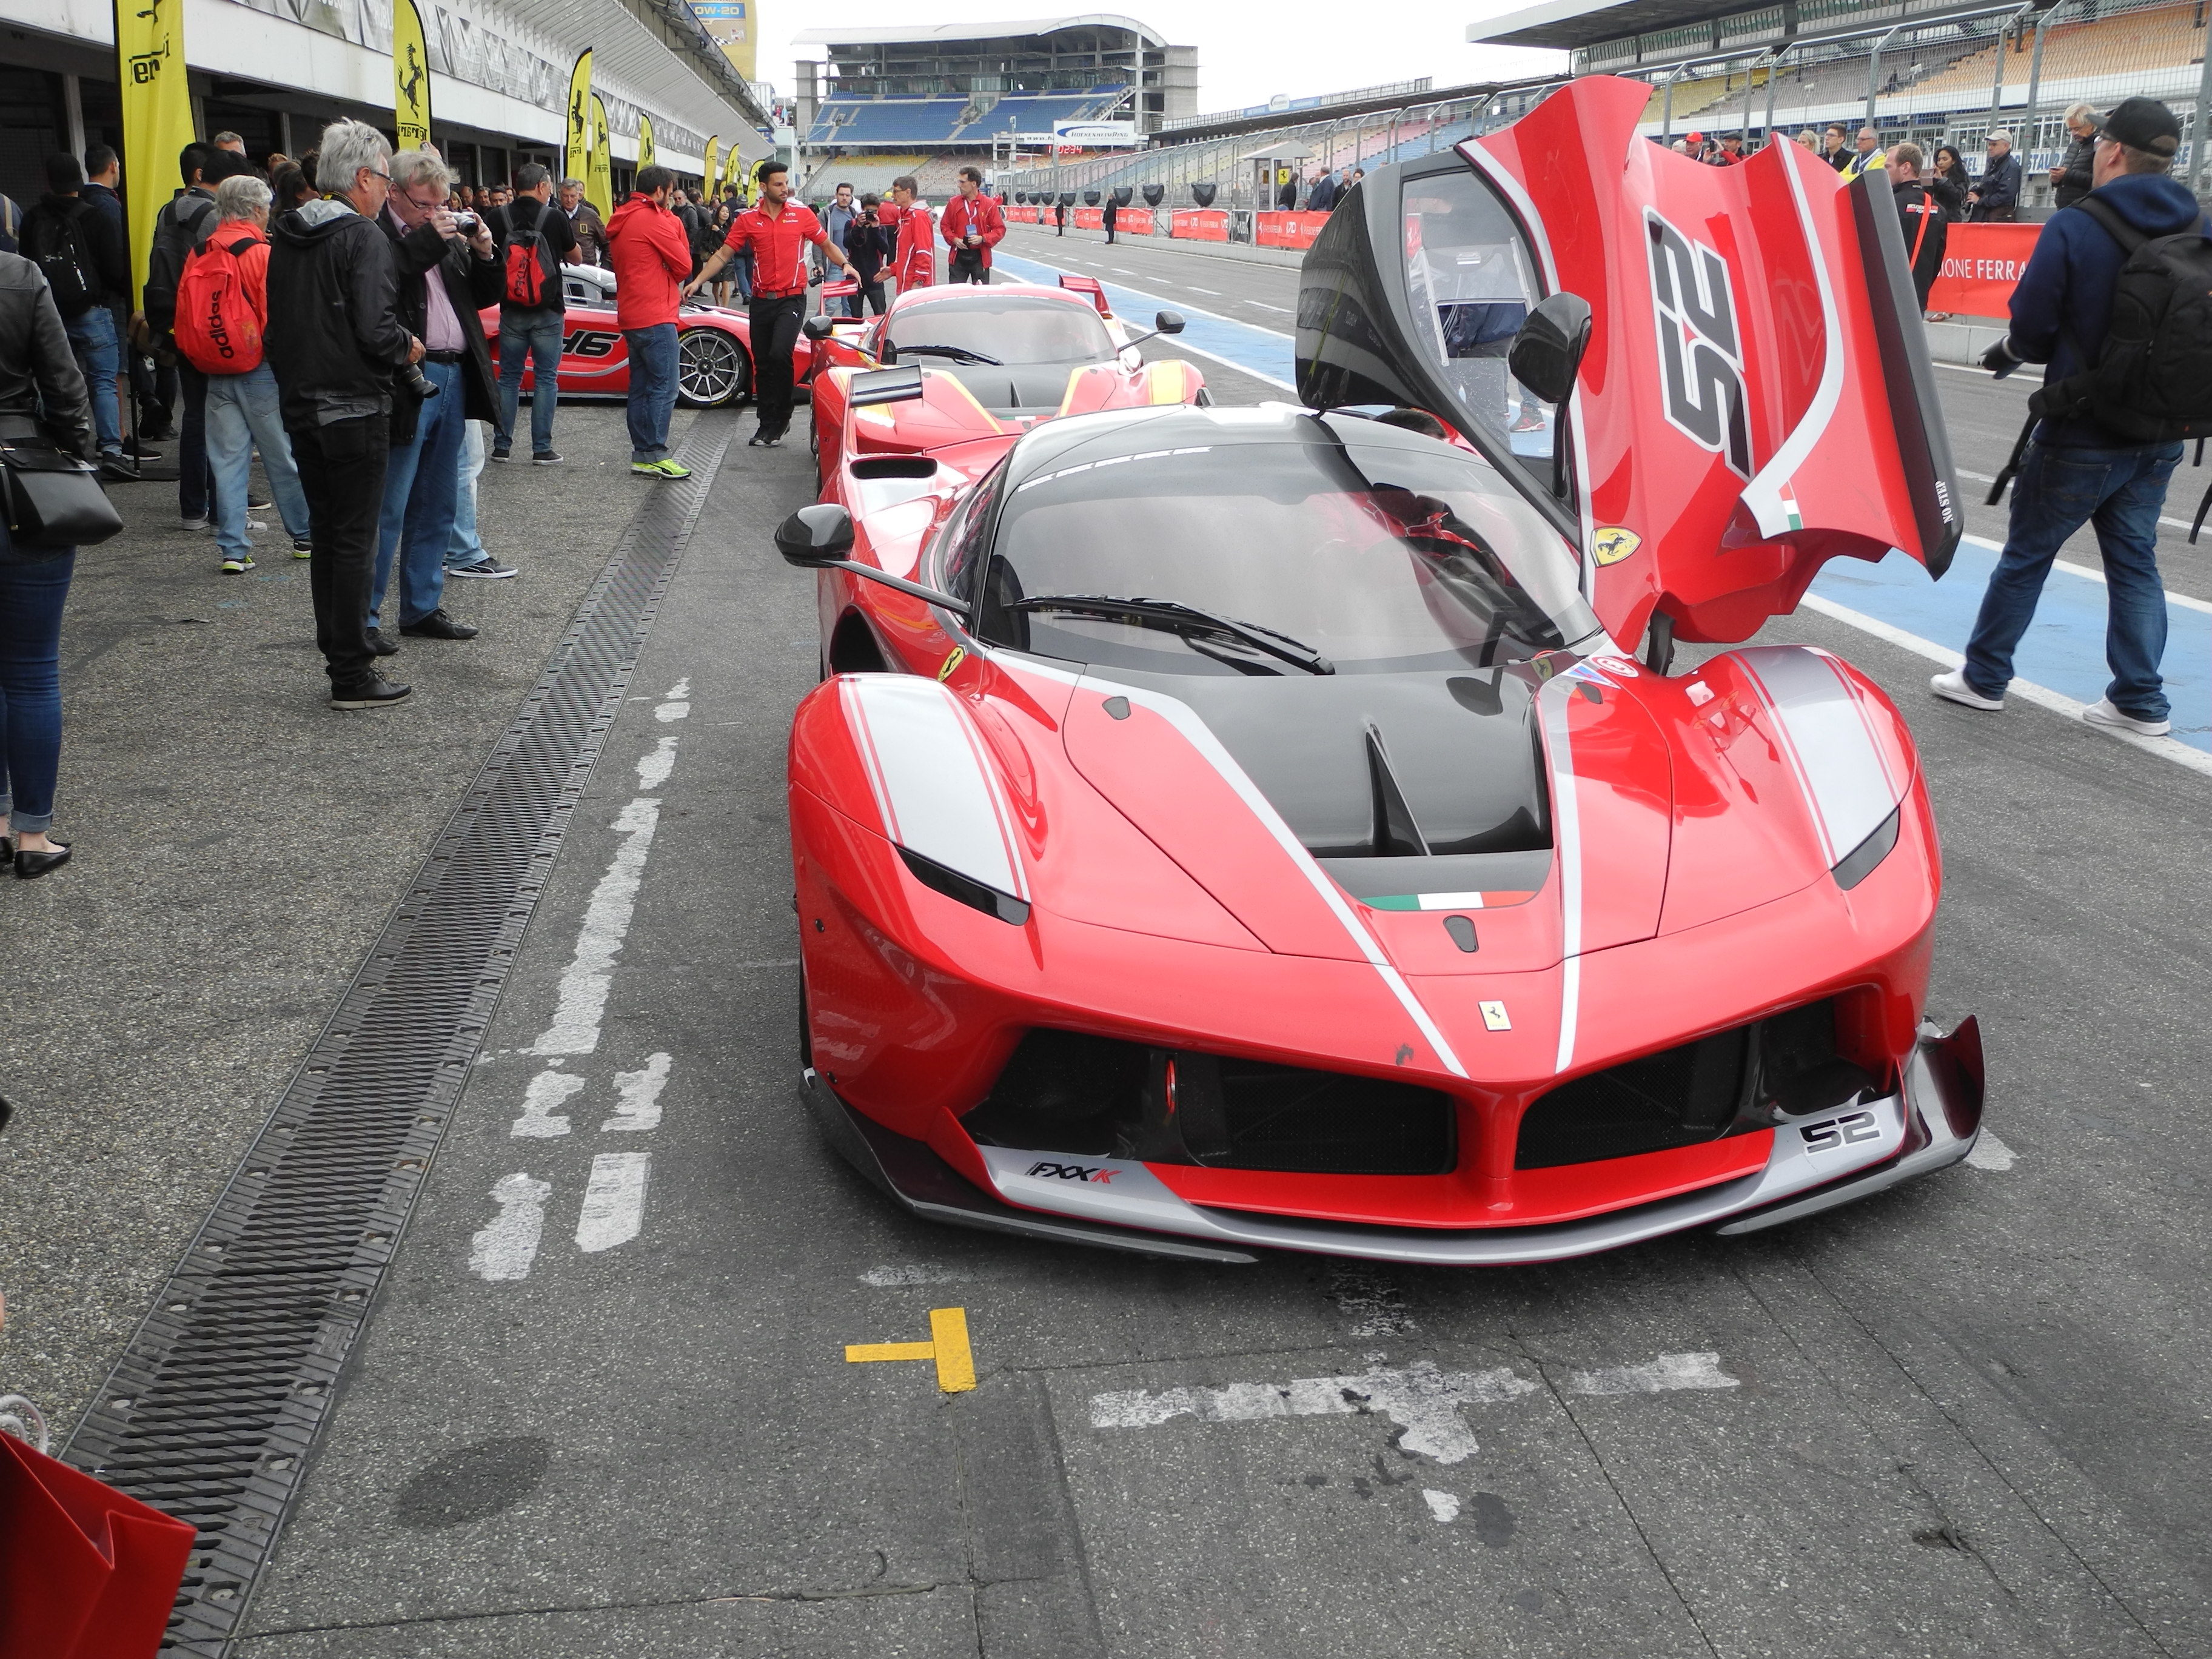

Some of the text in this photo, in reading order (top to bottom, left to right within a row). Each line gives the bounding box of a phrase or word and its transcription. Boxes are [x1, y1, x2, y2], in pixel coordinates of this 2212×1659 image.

[1937, 258, 2027, 281] IONE FERRA
[208, 290, 235, 359] adidas
[1643, 206, 1754, 483] 52
[1935, 480, 1954, 525] NO STEP
[1798, 1110, 1882, 1156] 52
